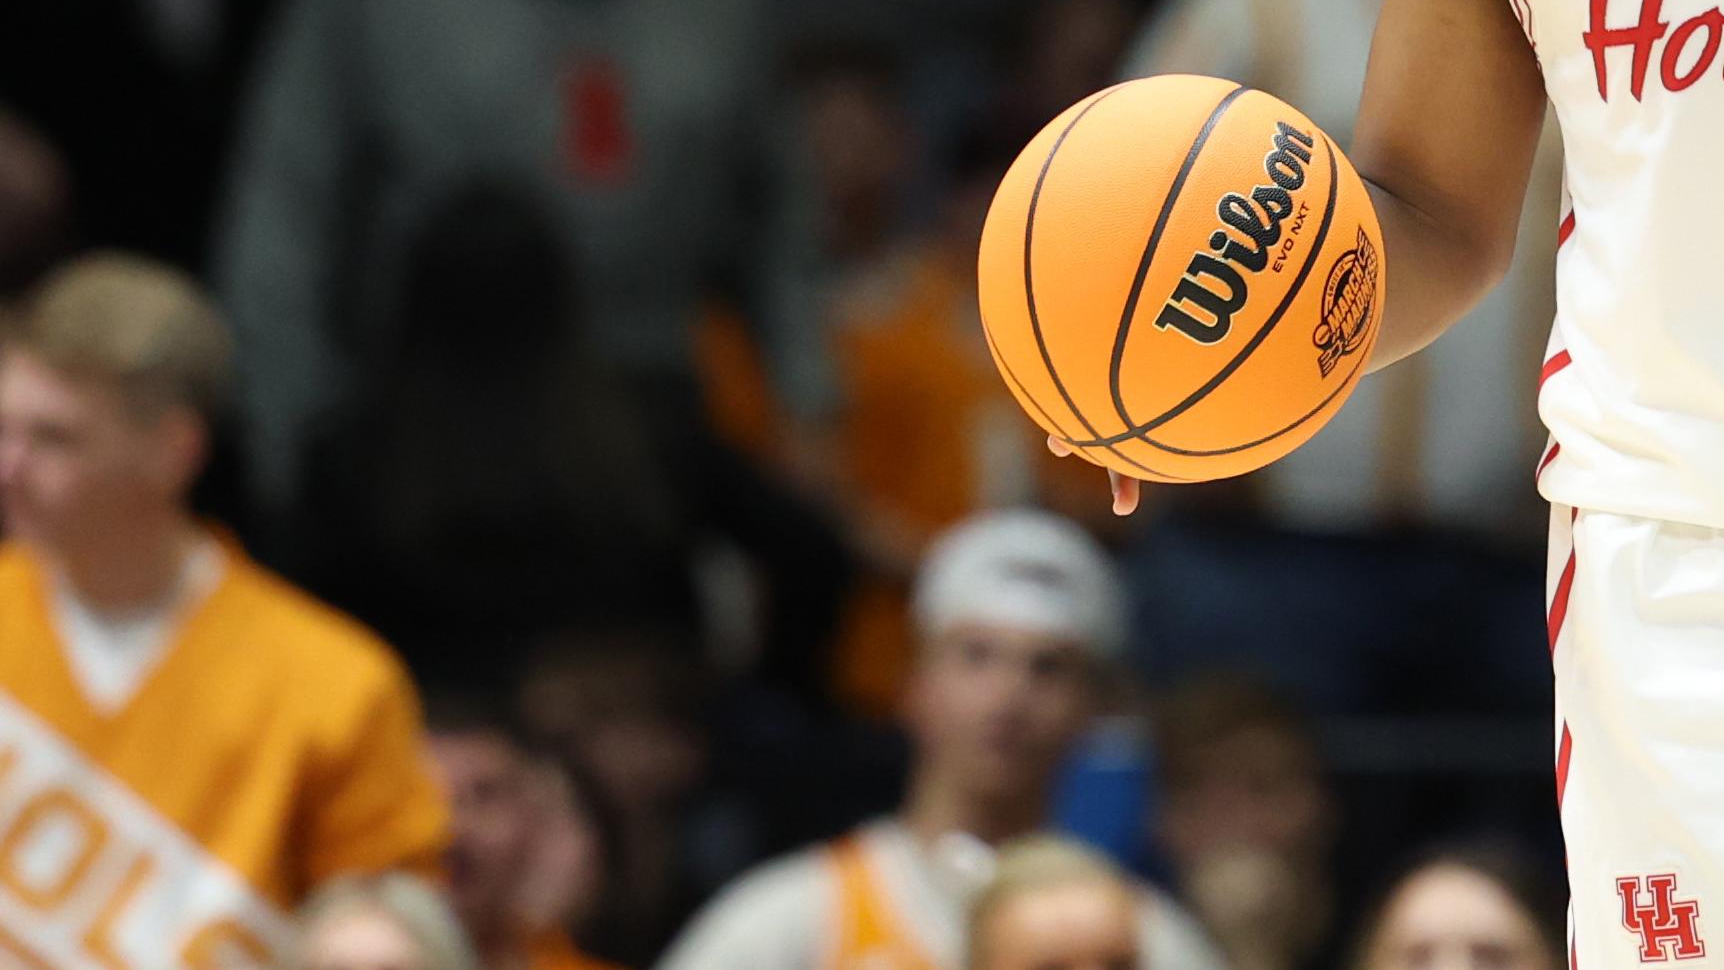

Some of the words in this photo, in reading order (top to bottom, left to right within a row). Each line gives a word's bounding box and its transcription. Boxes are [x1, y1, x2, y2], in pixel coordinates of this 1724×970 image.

[1152, 120, 1314, 345] Wilson
[1272, 239, 1294, 273] EVO
[1291, 201, 1310, 235] NXT
[1327, 260, 1364, 331] MARCH
[1616, 874, 1706, 962] UH
